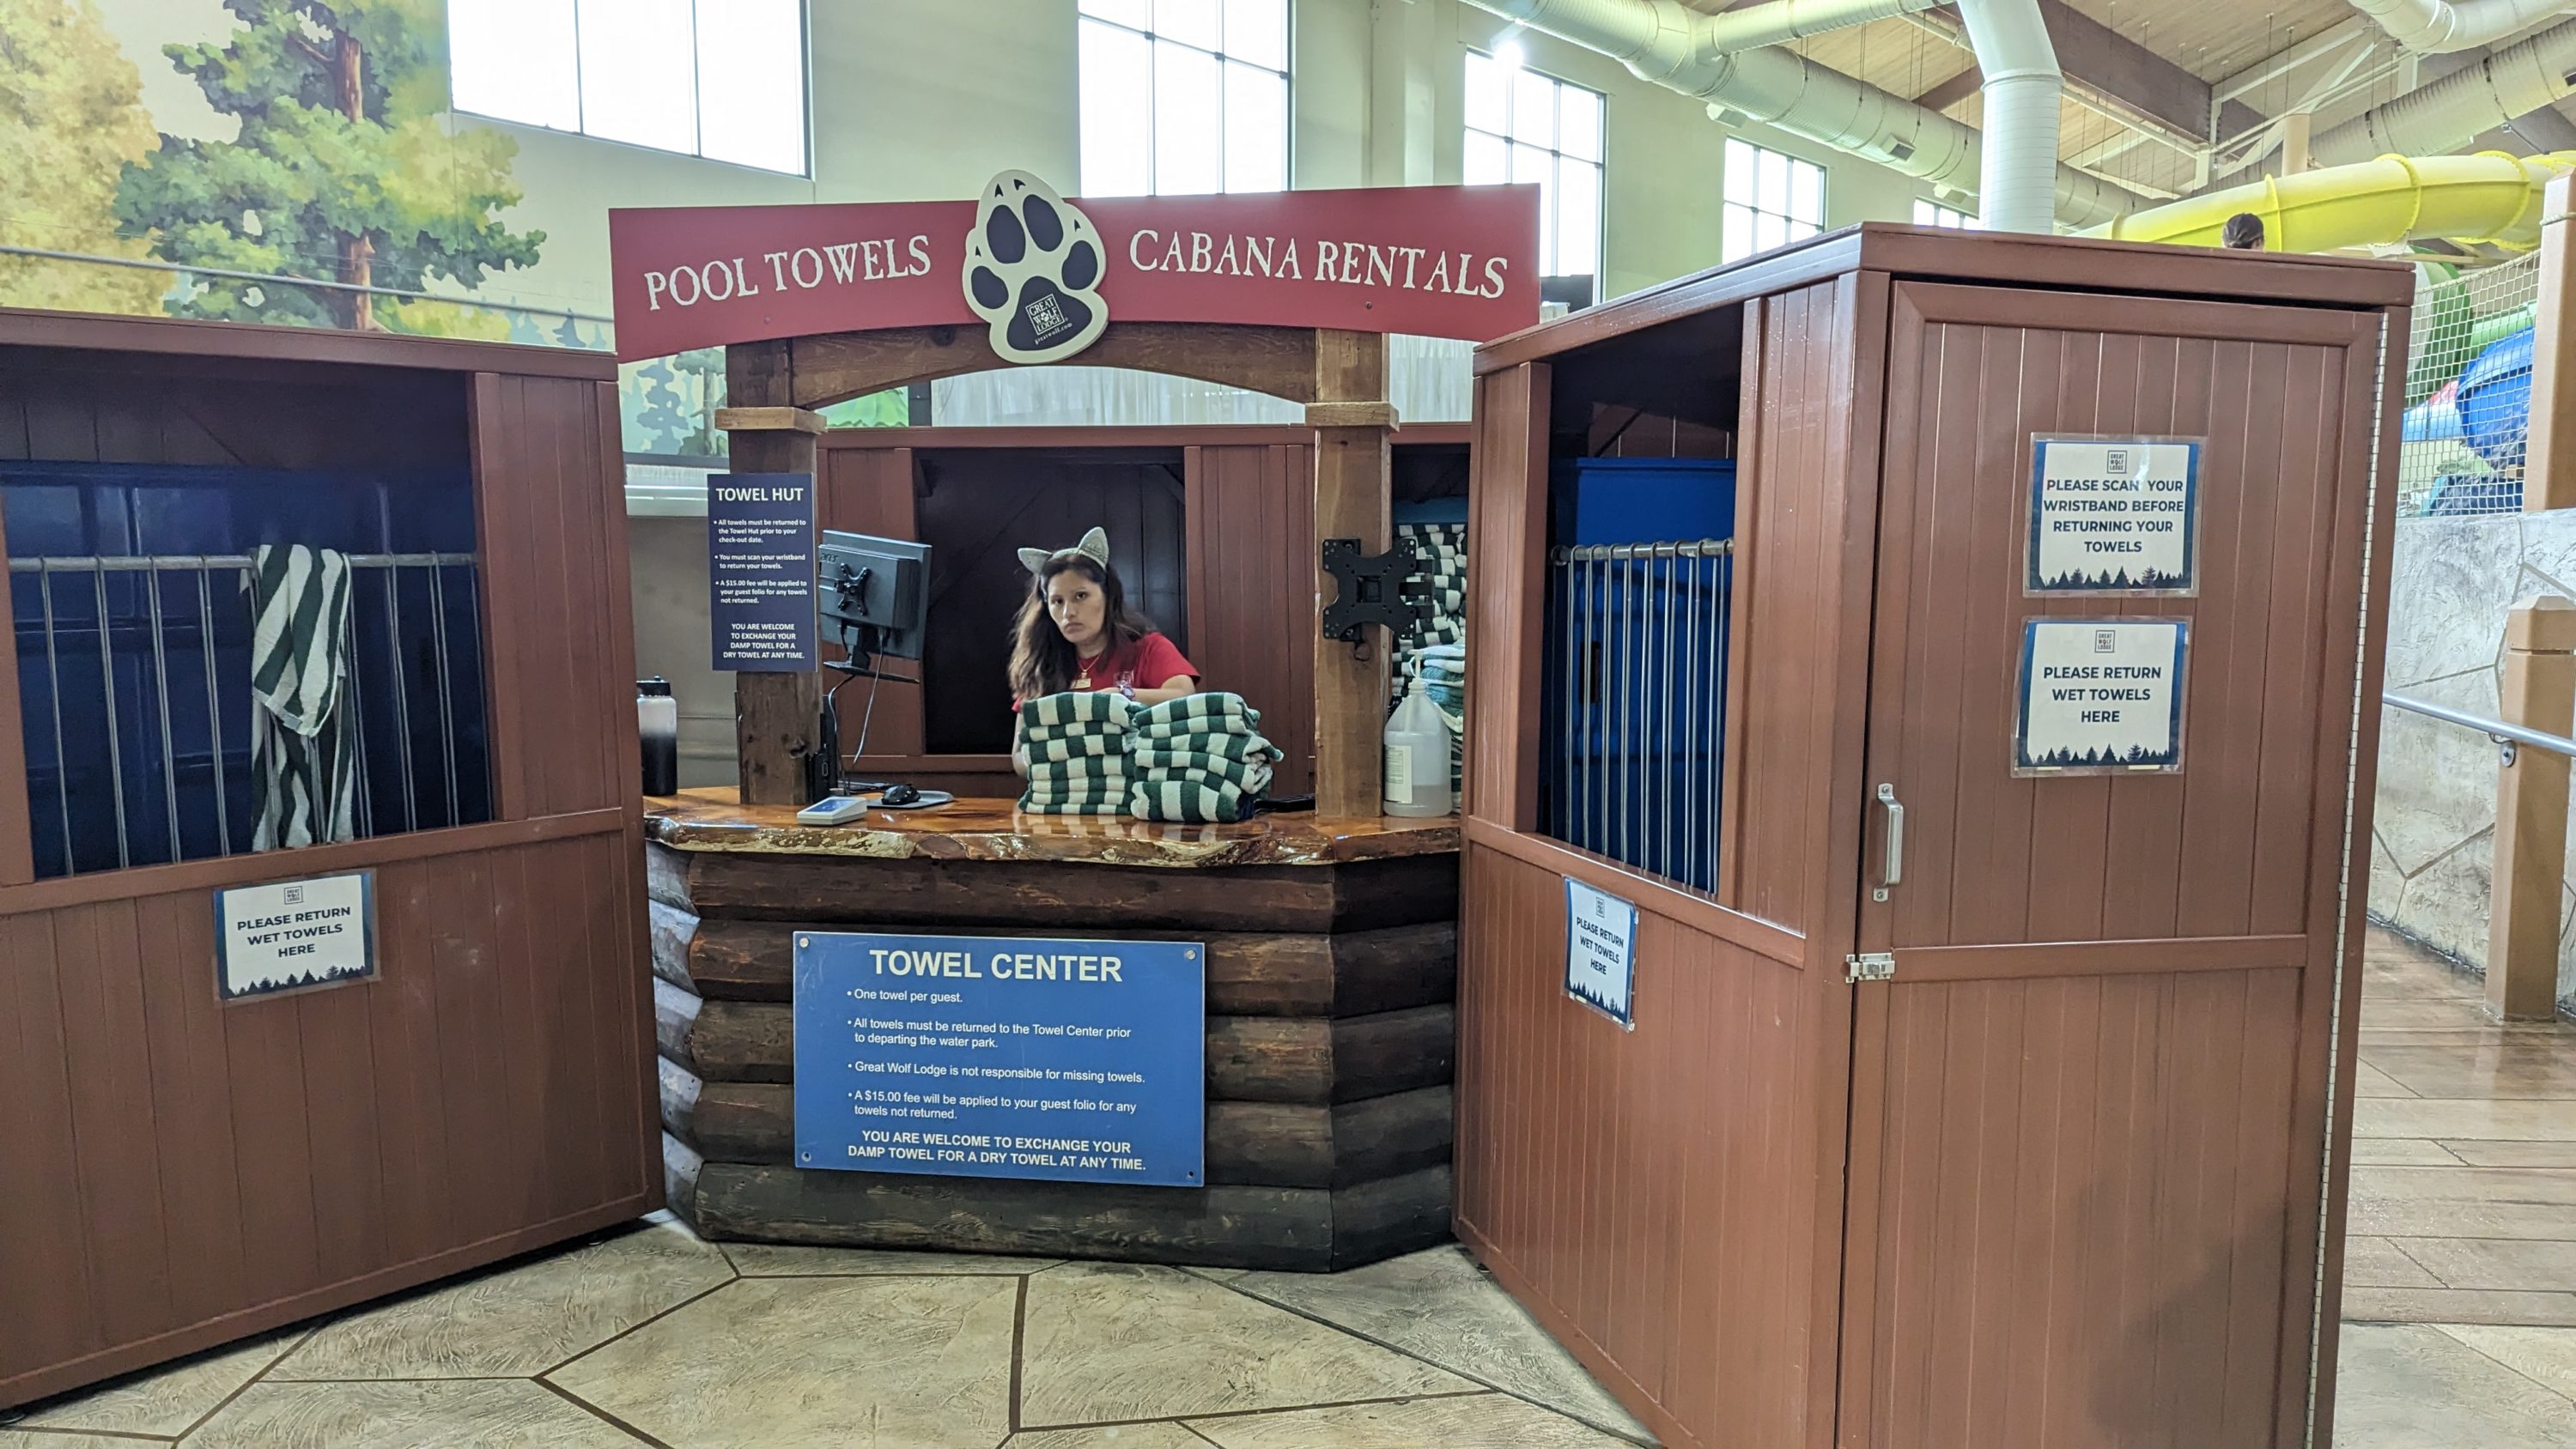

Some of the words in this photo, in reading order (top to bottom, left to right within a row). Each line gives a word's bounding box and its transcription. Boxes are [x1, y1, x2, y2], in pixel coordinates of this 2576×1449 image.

[1129, 229, 1302, 280] CABANA
[1315, 241, 1508, 299] RENTALS
[644, 258, 758, 311] POOL
[765, 235, 931, 291] TOWELS
[1029, 297, 1054, 316] GREAT
[1036, 317, 1061, 332] LODGE
[2047, 480, 2099, 491] PLEASE
[2102, 480, 2140, 491] SCAN
[2148, 481, 2184, 492] YOUR
[715, 488, 769, 501] TOWEL
[773, 488, 804, 501] HUT
[2044, 500, 2128, 512] WRISTBAND
[2132, 501, 2184, 512] BEFORE
[2053, 521, 2132, 532] RETURNING
[2136, 521, 2173, 532] YOUR
[2085, 542, 2142, 552] TOWELS
[2044, 667, 2099, 678] PLEASE
[2104, 667, 2161, 678] RETURN
[2052, 688, 2085, 700] WET
[2090, 688, 2150, 700] TOWELS
[2081, 711, 2120, 723] HERE
[238, 914, 291, 931] PLEASE
[295, 906, 350, 922] RETURN
[247, 933, 280, 945] WET
[284, 924, 343, 941] TOWELS
[1577, 917, 1598, 936] PLEASE
[1600, 928, 1624, 949] RETURN
[278, 943, 315, 957] HERE
[1580, 935, 1593, 950] WET
[1595, 943, 1619, 964] TOWELS
[869, 949, 981, 979] TOWEL
[991, 953, 1123, 983] CENTER
[1590, 959, 1607, 975] HERE
[854, 989, 877, 999] One
[880, 990, 908, 1001] towel
[910, 993, 927, 1003] per
[931, 993, 963, 1004] guest.
[854, 1018, 867, 1028] All
[870, 1019, 903, 1030] towels
[907, 1021, 933, 1030] must
[935, 1021, 949, 1031] be
[951, 1023, 996, 1033] returned
[999, 1023, 1010, 1034] to
[1012, 1024, 1030, 1034] the
[1032, 1024, 1063, 1035] Towel
[1066, 1025, 1103, 1037] Center
[1106, 1028, 1132, 1040] prior
[854, 1033, 865, 1042] to
[868, 1034, 917, 1046] departing
[920, 1035, 936, 1046] the
[939, 1037, 969, 1046] water
[972, 1037, 998, 1049] park.
[855, 1061, 884, 1072] Great
[887, 1063, 912, 1073] Wolf
[914, 1064, 946, 1076] Lodge
[950, 1065, 958, 1076] is
[962, 1067, 979, 1076] not
[981, 1068, 1042, 1079] responsible
[1046, 1069, 1060, 1080] for
[1063, 1070, 1104, 1083] missing
[1108, 1071, 1145, 1083] towels.
[854, 1091, 863, 1100] A
[865, 1090, 901, 1101] $15.00
[903, 1092, 920, 1103] fee
[923, 1094, 939, 1104] will
[943, 1094, 956, 1105] be
[959, 1095, 998, 1107] applied
[1001, 1097, 1012, 1106] to
[1014, 1100, 1038, 1109] your
[1041, 1100, 1071, 1111] guest
[1073, 1099, 1096, 1111] folio
[1099, 1100, 1114, 1111] for
[1116, 1103, 1137, 1114] any
[854, 1106, 888, 1115] towels
[891, 1107, 908, 1117] not
[910, 1109, 957, 1119] returned.
[862, 1131, 890, 1142] YOU
[893, 1132, 920, 1143] ARE
[923, 1133, 990, 1147] WELCOME
[994, 1137, 1012, 1148] TO
[1015, 1137, 1090, 1151] EXCHANGE
[1092, 1141, 1131, 1153] YOUR
[848, 1146, 885, 1157] DAMP
[888, 1148, 934, 1160] TOWEL
[938, 1149, 964, 1161] FOR
[968, 1152, 977, 1161] A
[981, 1152, 1006, 1164] DRY
[1010, 1153, 1058, 1166] TOWEL
[1060, 1156, 1076, 1167] AT
[1079, 1157, 1108, 1168] ANY
[1110, 1157, 1146, 1170] TIME.
